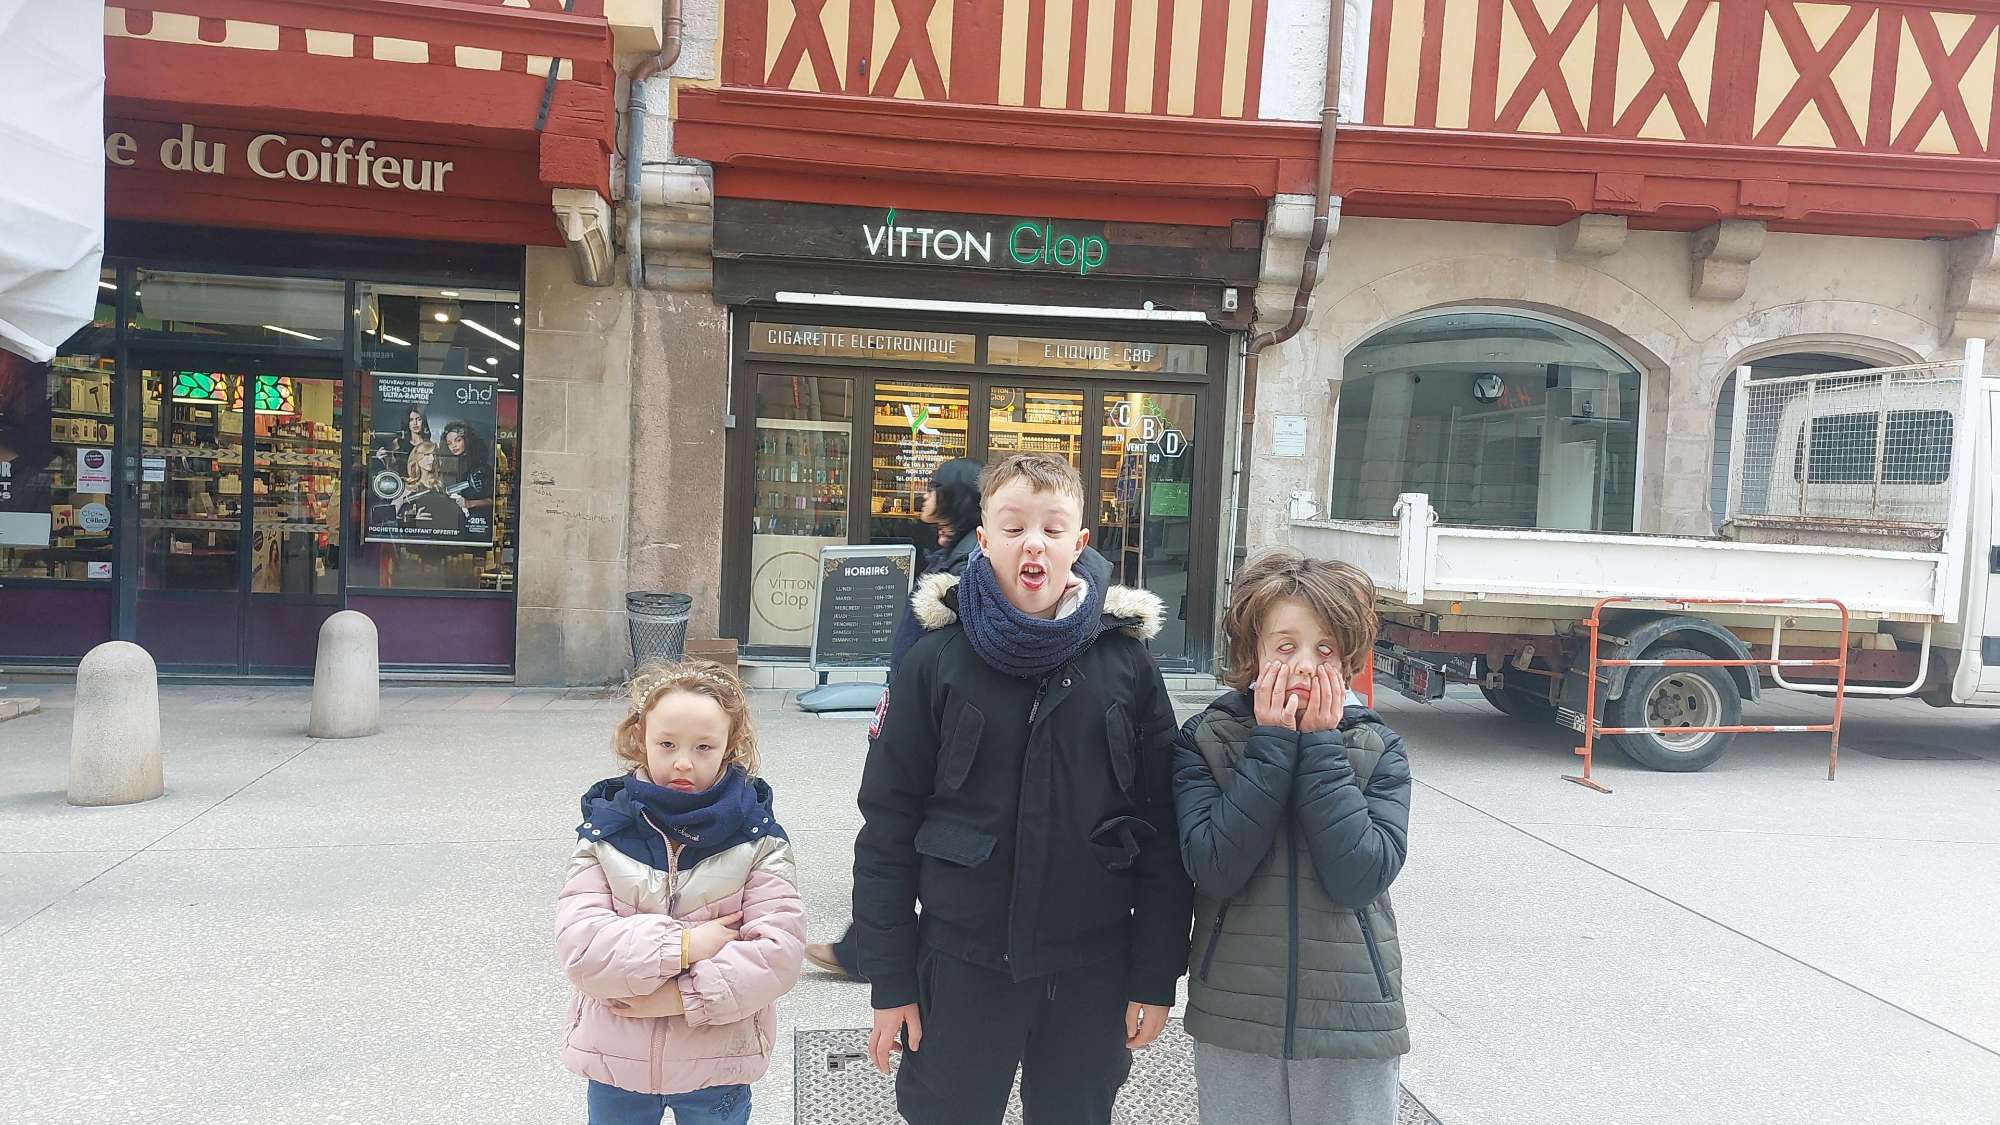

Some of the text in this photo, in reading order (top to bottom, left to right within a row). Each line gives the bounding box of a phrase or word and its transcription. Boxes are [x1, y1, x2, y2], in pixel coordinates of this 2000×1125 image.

[159, 123, 226, 175] du
[246, 132, 455, 194] Coiffeur
[863, 208, 1108, 275] VITTON Clop
[768, 329, 957, 354] CIGARETTE ELECTRONIQUE
[456, 383, 492, 404] ghd
[1126, 443, 1148, 452] VENTE
[1149, 453, 1160, 463] ICI
[769, 571, 816, 590] VITTON
[844, 566, 889, 577] HORAIRES
[771, 592, 809, 609] Clop
